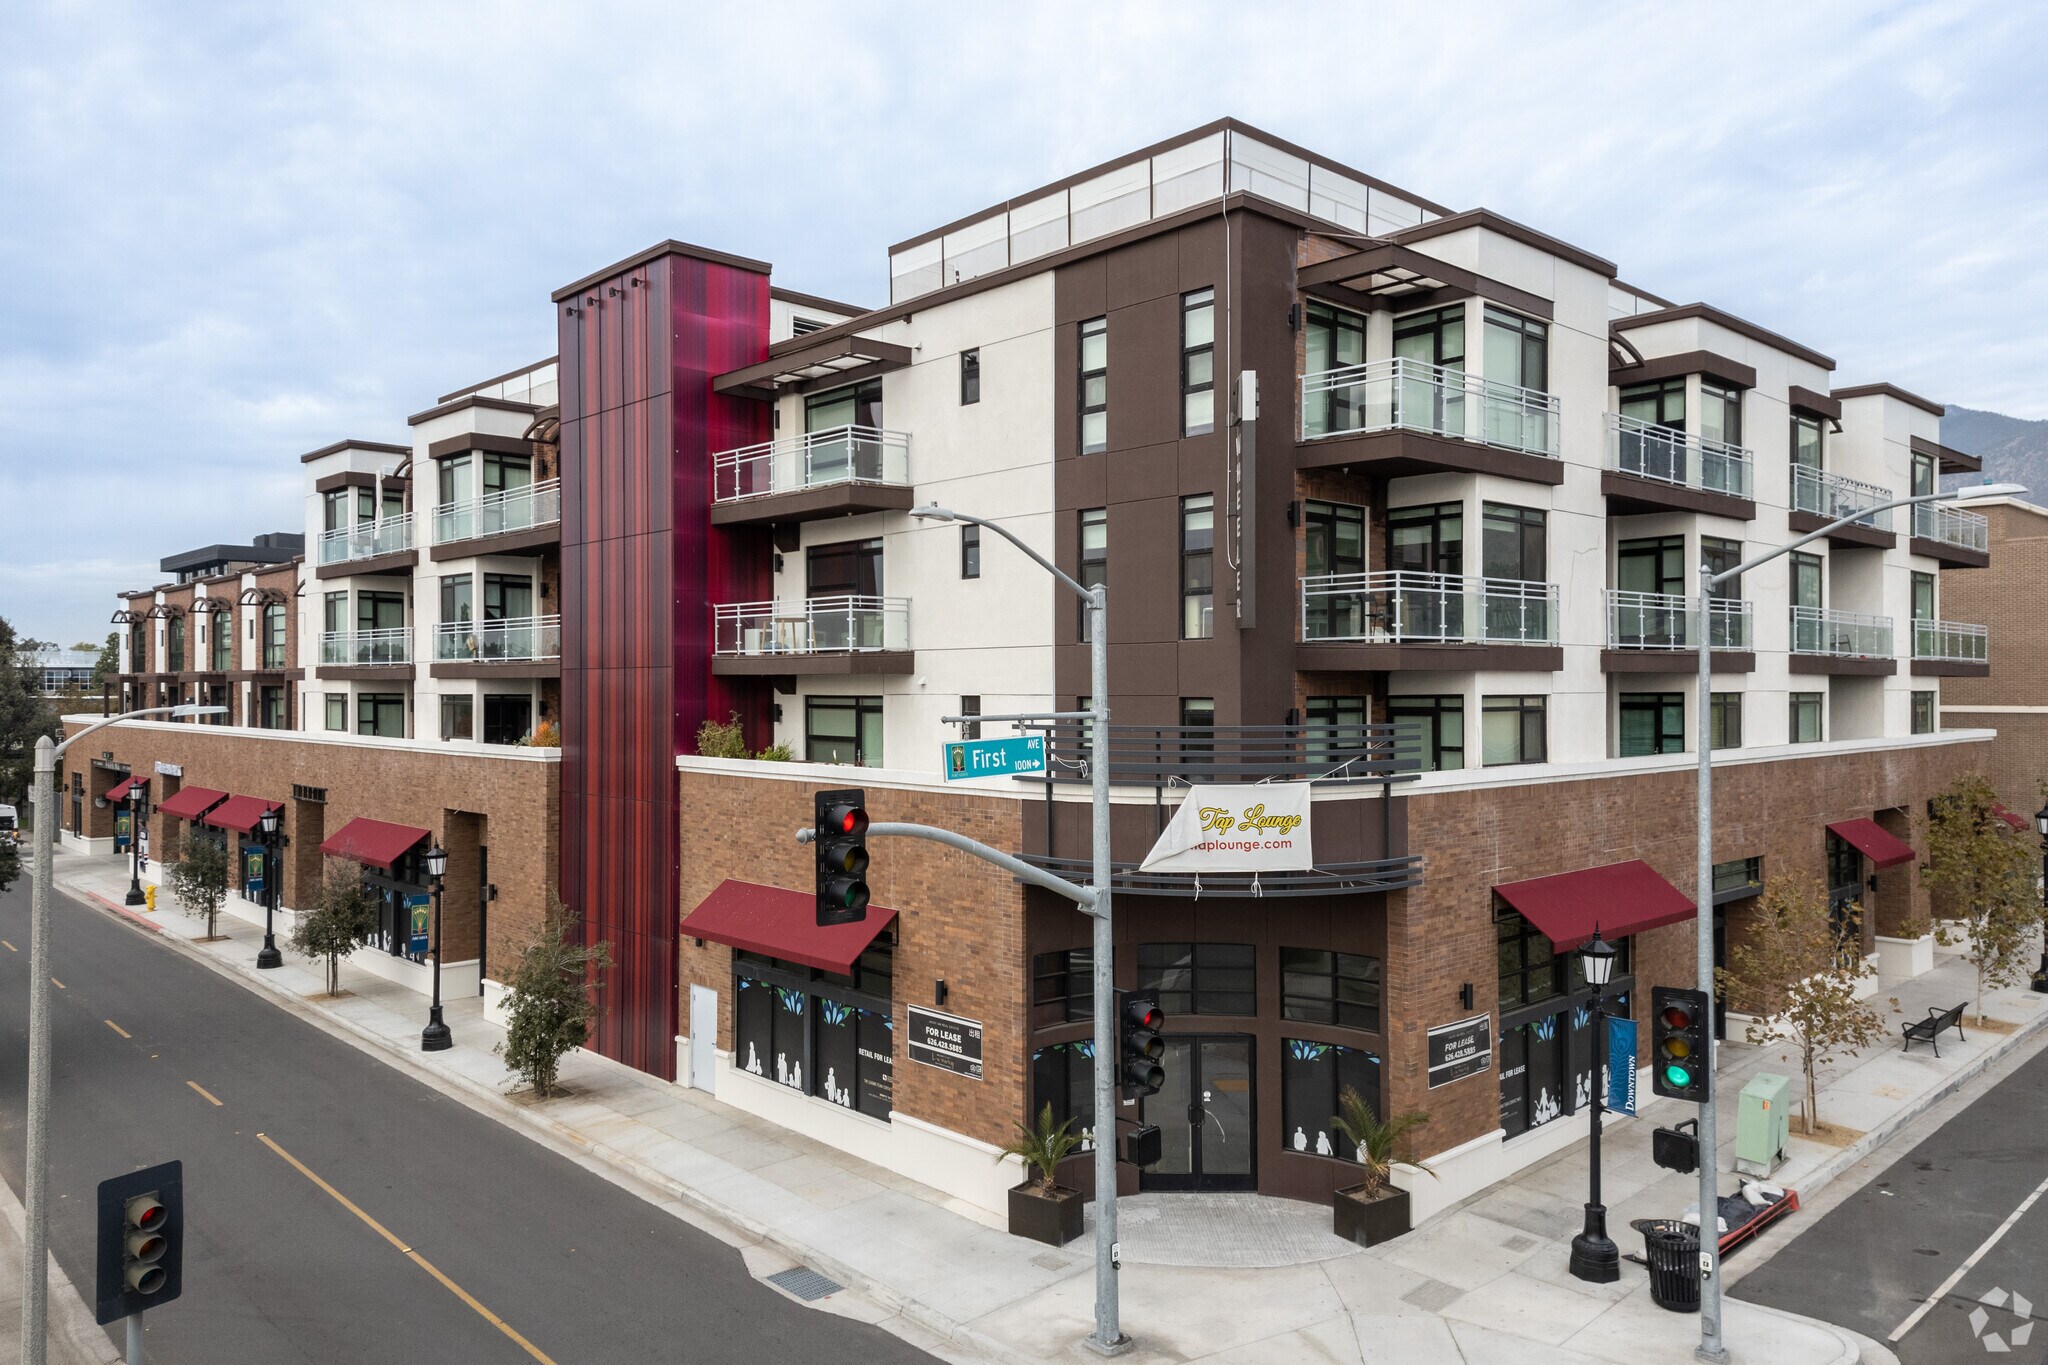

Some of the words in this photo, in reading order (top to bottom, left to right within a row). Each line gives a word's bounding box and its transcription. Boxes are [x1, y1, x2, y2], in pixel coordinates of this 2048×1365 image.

[1027, 738, 1040, 750] AVE
[972, 748, 1007, 769] First
[1014, 759, 1032, 771] 100N
[1199, 807, 1235, 835] Tap
[1238, 803, 1302, 835] Lounge
[1190, 840, 1292, 852] aplounge.com
[925, 1026, 939, 1037] FOR
[940, 1030, 962, 1043] LEASE
[927, 1037, 963, 1053] 626.428.5885
[1445, 1041, 1457, 1051] FOR
[1458, 1035, 1474, 1048] LEASE
[859, 1048, 873, 1058] RETAIL
[874, 1052, 883, 1061] FOR
[884, 1056, 893, 1064] LEA
[1514, 1064, 1526, 1075] LEASE
[1625, 1055, 1636, 1111] DOWNTOWN
